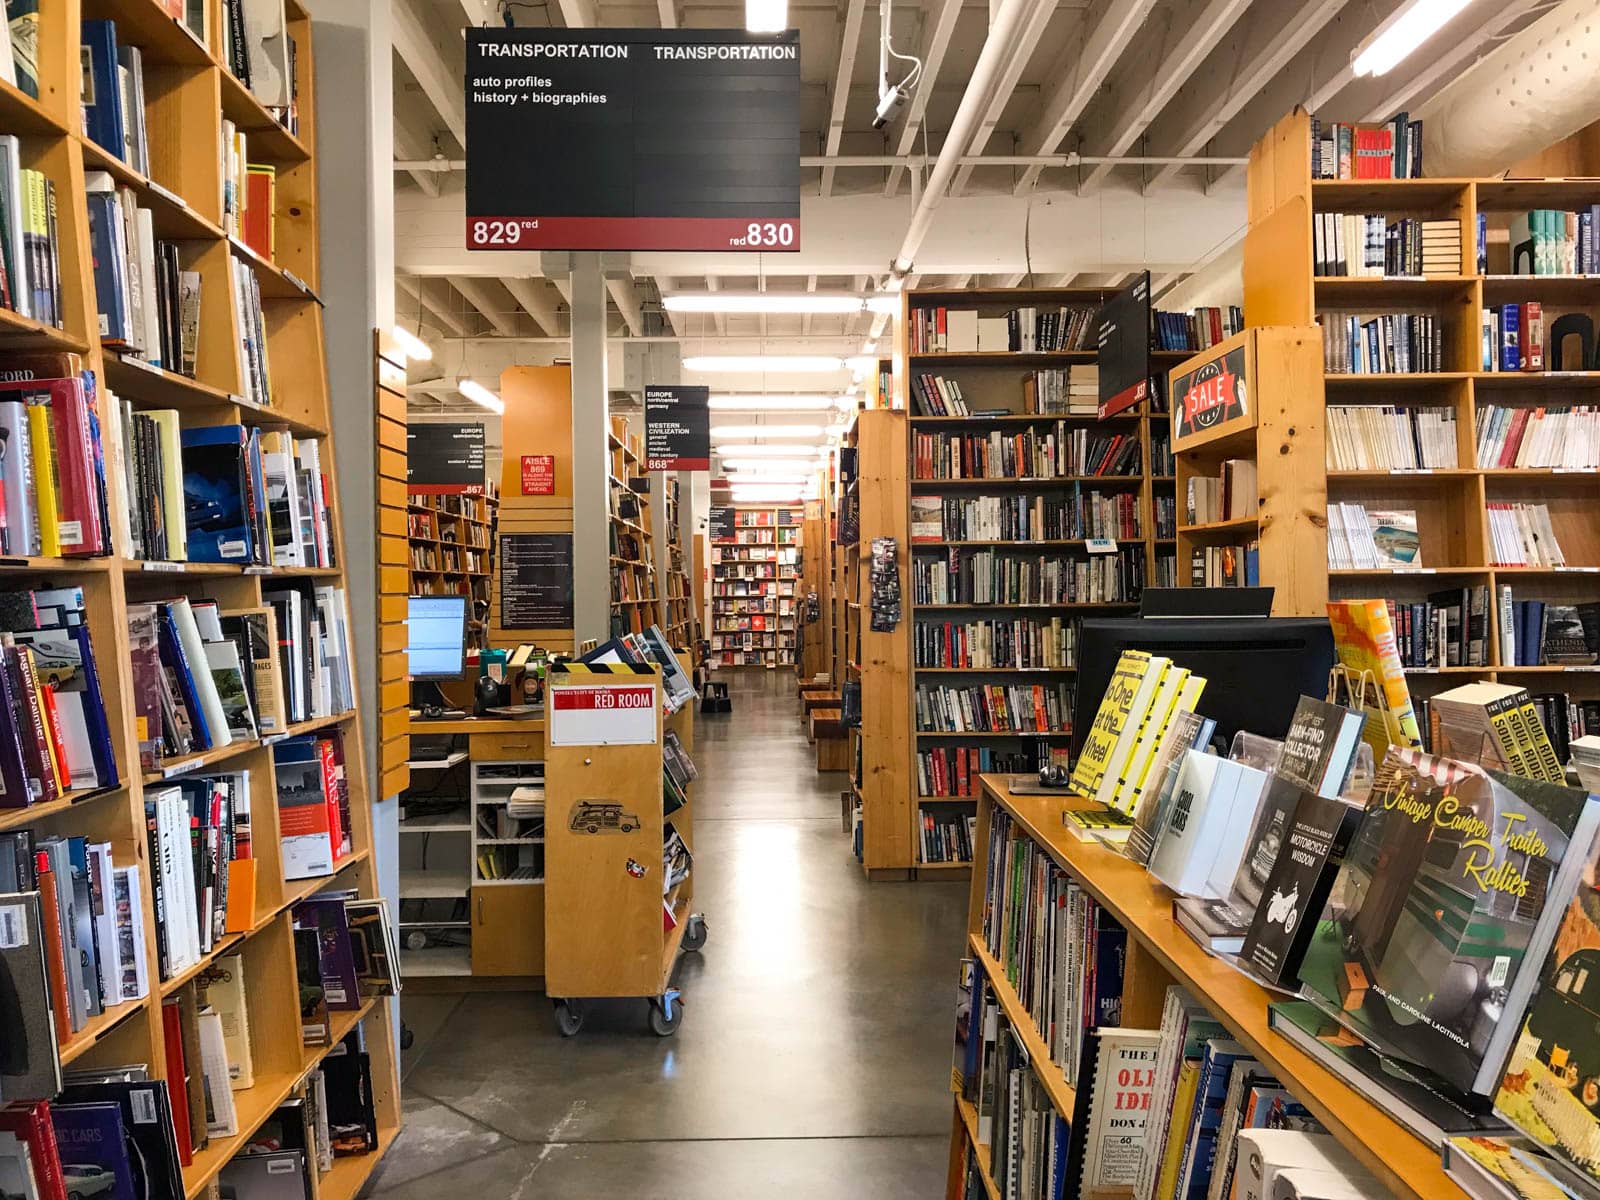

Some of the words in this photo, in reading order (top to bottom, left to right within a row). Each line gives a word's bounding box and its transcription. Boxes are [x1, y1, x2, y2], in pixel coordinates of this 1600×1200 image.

[478, 43, 628, 58] TRANSPORTATION
[654, 46, 796, 60] TRANSPORTATION
[473, 77, 501, 87] auto
[505, 75, 552, 88] profiles
[473, 92, 517, 105] history
[520, 93, 529, 101] +
[532, 92, 607, 106] biographies
[473, 221, 521, 244] 829
[521, 219, 539, 229] red
[729, 236, 746, 246] red
[747, 223, 794, 246] 830
[1190, 376, 1225, 412] SALE
[525, 457, 551, 465] AISLE
[648, 459, 667, 469] 868
[466, 485, 483, 494] 867
[18, 651, 34, 690] Jaguar
[29, 696, 44, 740] Daimler
[594, 694, 615, 708] RED
[618, 693, 650, 707] ROOM
[1113, 679, 1134, 705] One
[1517, 693, 1529, 702] FOX
[1102, 709, 1119, 731] the
[1508, 713, 1528, 747] SOUL
[1494, 718, 1514, 753] SOUL
[1524, 708, 1544, 742] SOUL
[1539, 743, 1563, 782] RIDER
[1285, 740, 1321, 762] COLLECTOR
[1178, 789, 1195, 813] COOL
[1384, 780, 1431, 823] Vintage
[1434, 796, 1490, 839] Camper
[1289, 833, 1329, 857] MOTORCYCLE
[1500, 812, 1549, 858] Trailer
[1291, 848, 1316, 868] WISDOM
[1462, 839, 1531, 898] Rallies
[1372, 984, 1387, 998] PAUL
[1387, 993, 1400, 1006] AND
[1401, 1001, 1431, 1025] CAROLINE
[1431, 1020, 1470, 1049] LACITINOLA
[1119, 1049, 1148, 1060] THE
[1110, 1118, 1137, 1128] DON
[1120, 1137, 1132, 1145] 60
